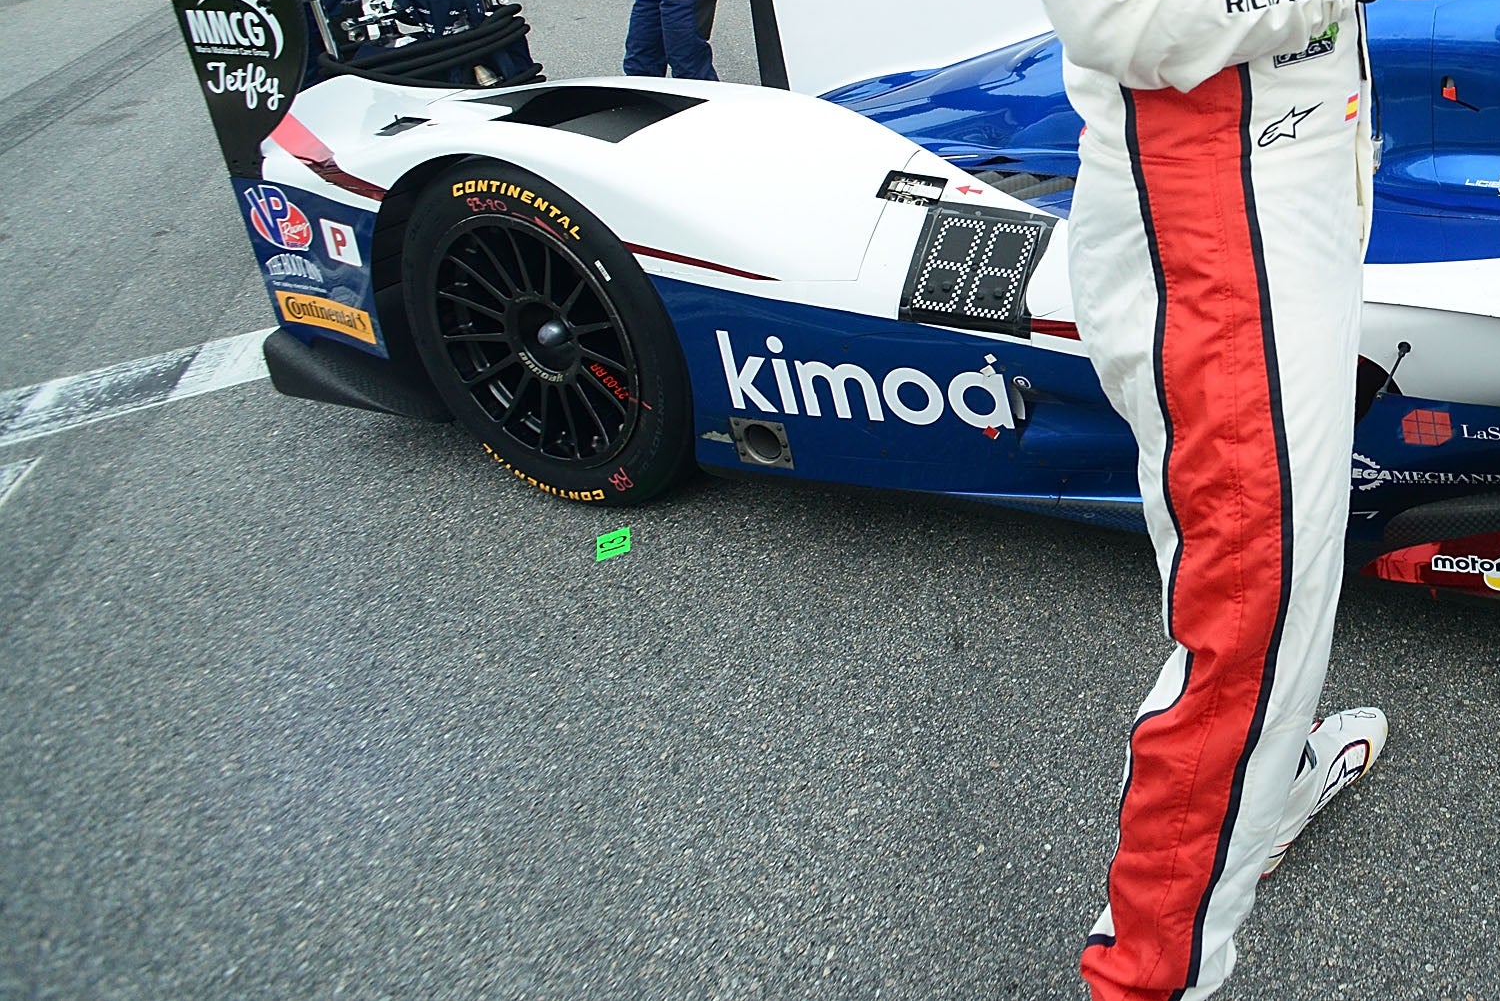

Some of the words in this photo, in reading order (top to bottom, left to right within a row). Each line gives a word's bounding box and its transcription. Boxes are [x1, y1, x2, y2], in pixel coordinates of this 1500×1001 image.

[185, 9, 267, 47] MMCG
[206, 61, 285, 111] Jetfly
[244, 185, 290, 247] VP
[452, 180, 581, 241] CONTINENTAL
[331, 226, 347, 257] P
[285, 296, 356, 329] Continental
[715, 330, 1025, 430] kimoa
